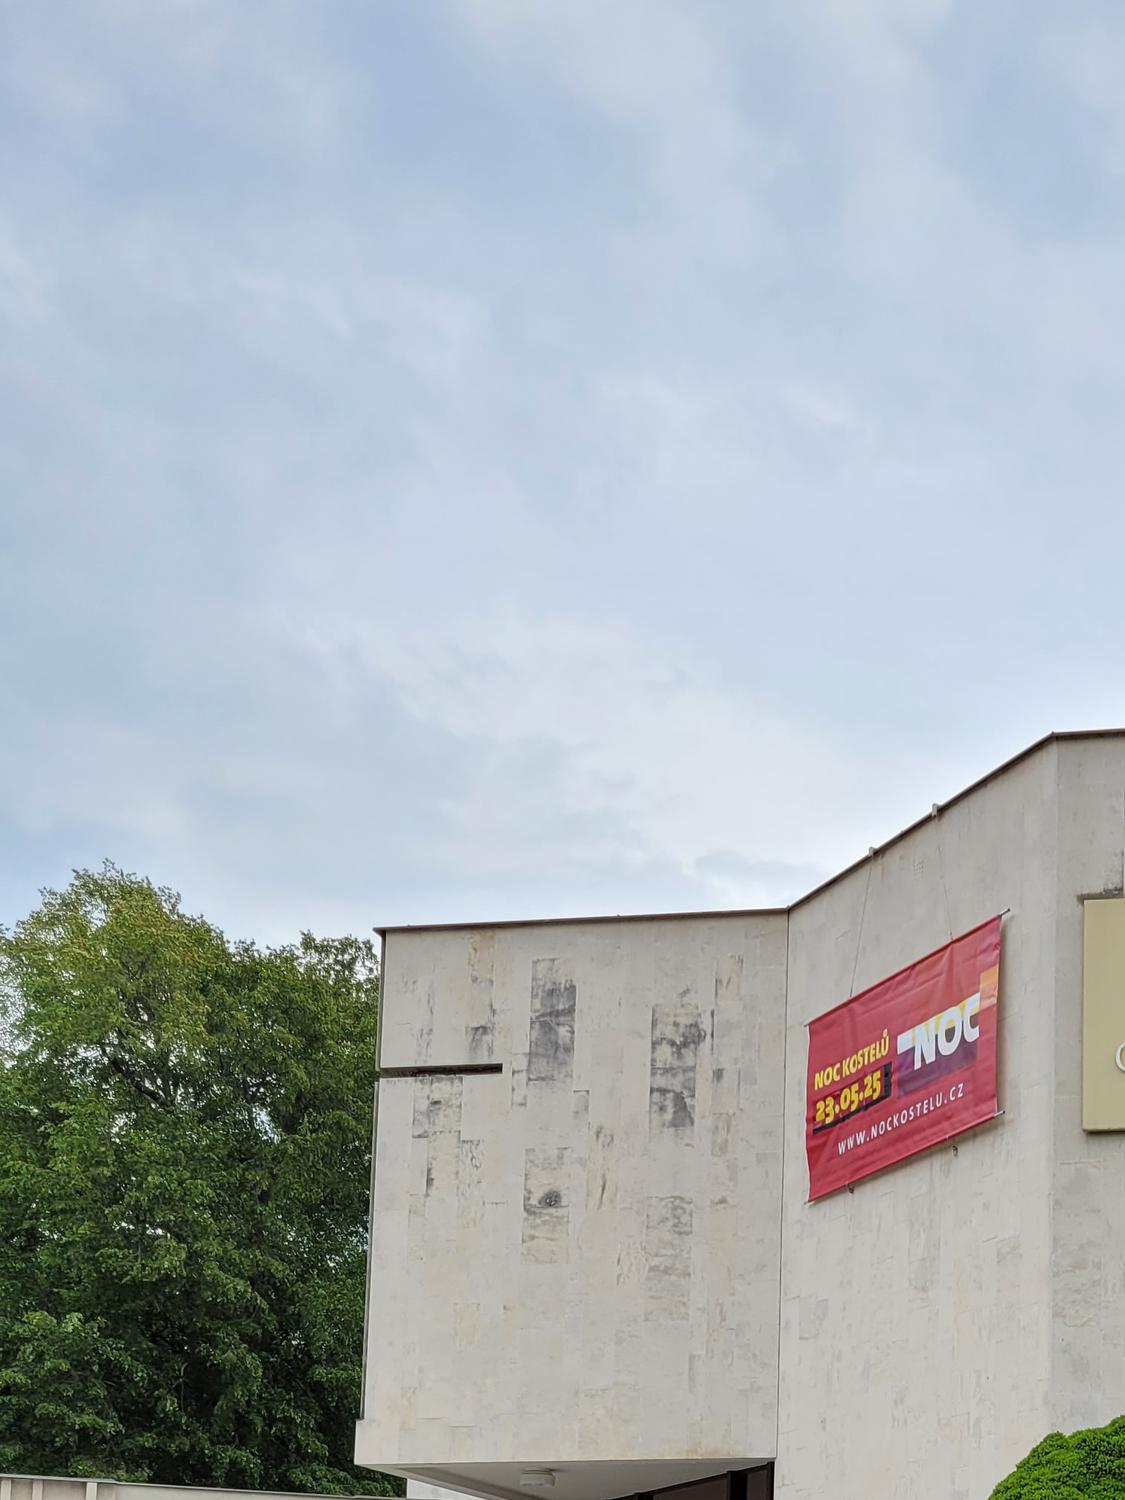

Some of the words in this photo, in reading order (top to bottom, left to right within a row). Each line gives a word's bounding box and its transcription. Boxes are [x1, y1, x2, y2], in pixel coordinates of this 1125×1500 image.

[814, 1064, 841, 1091] NOC
[842, 1028, 890, 1074] KOSTELŮ
[913, 992, 980, 1070] NOC
[815, 1070, 882, 1124] 23.05.25
[837, 1082, 964, 1155] WWW.NOCKOSTELU.CZ
